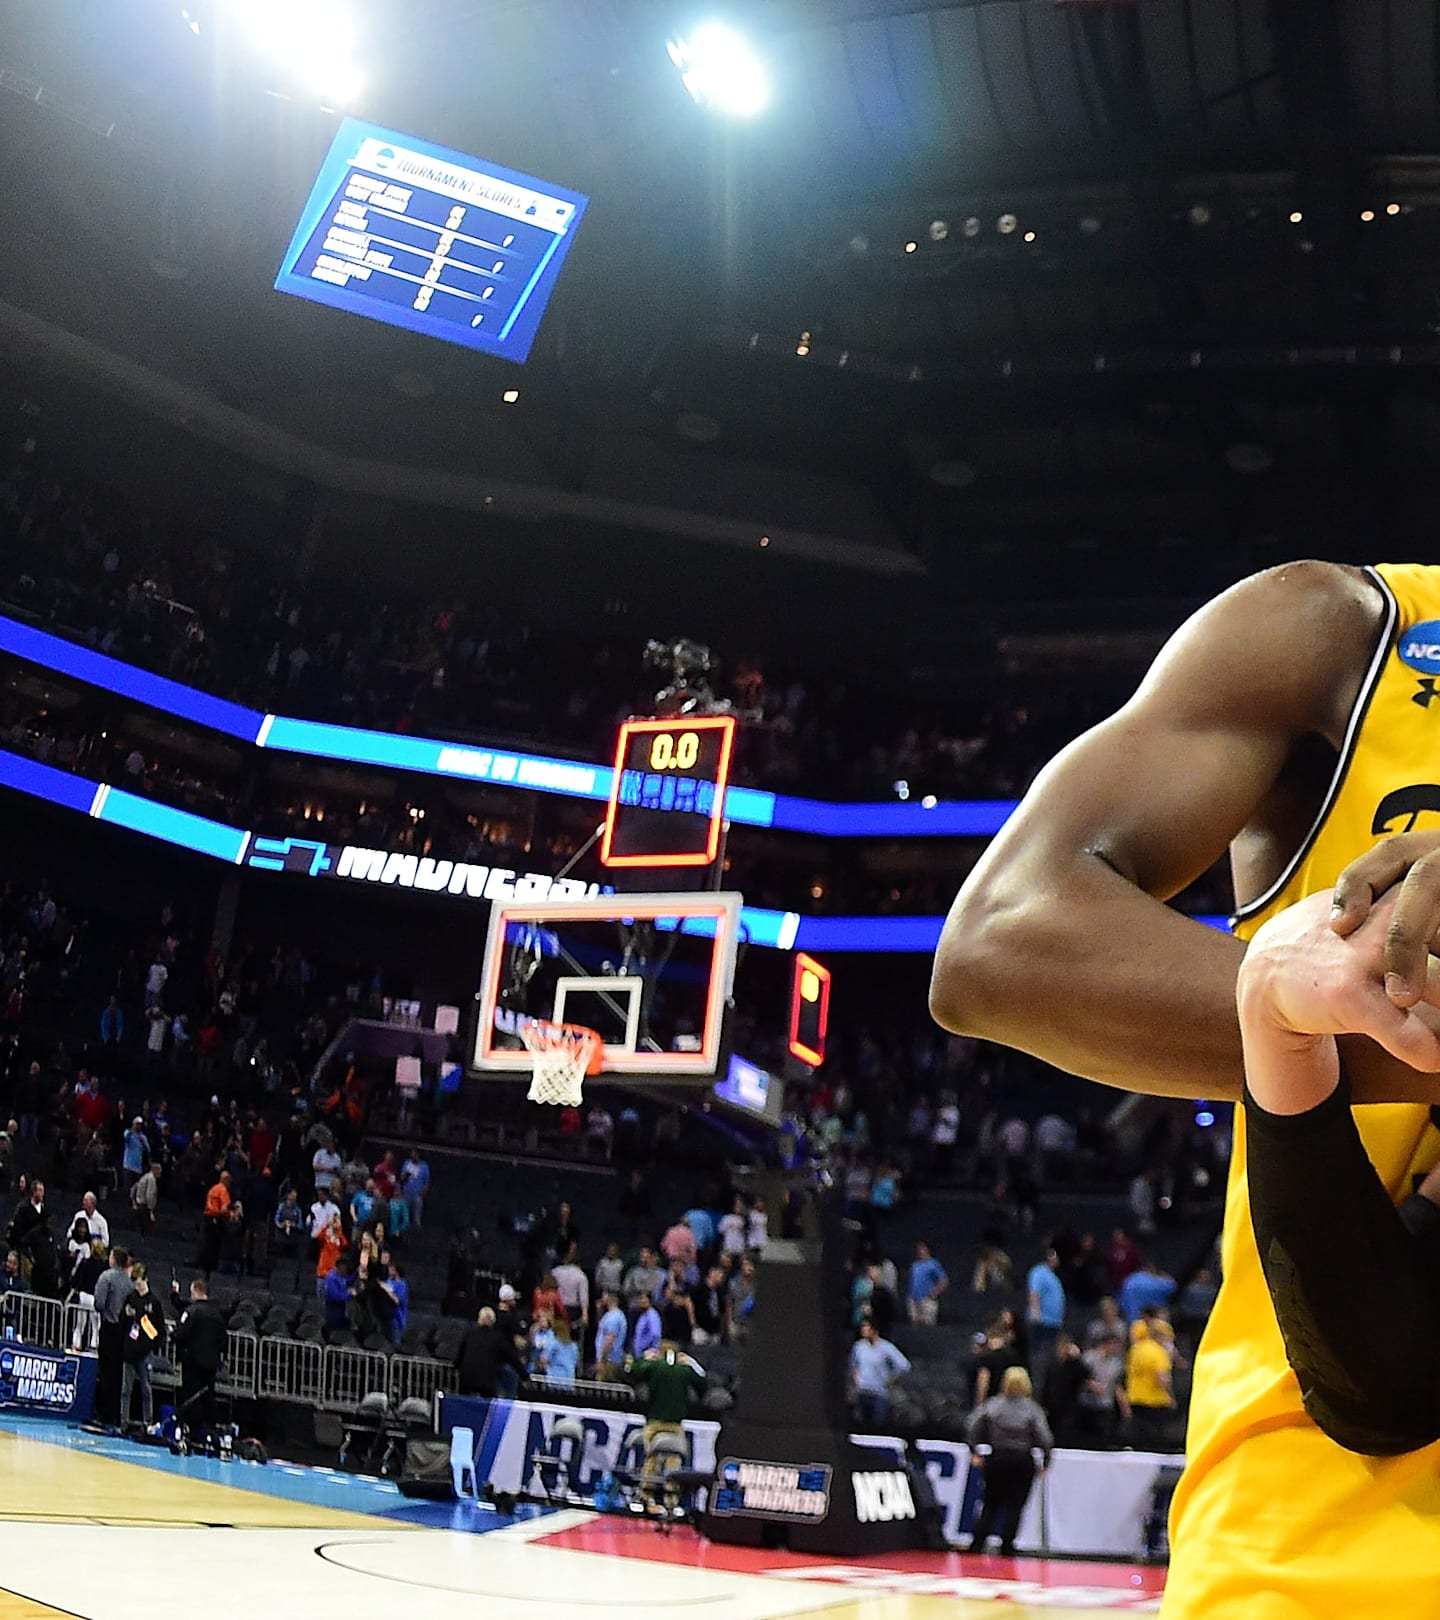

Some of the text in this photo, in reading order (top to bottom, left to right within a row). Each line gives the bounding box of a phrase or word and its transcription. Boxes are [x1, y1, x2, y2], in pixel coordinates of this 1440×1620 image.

[650, 731, 700, 771] 0.0
[12, 1354, 57, 1381] MARCH
[16, 1377, 75, 1404] MADNESS
